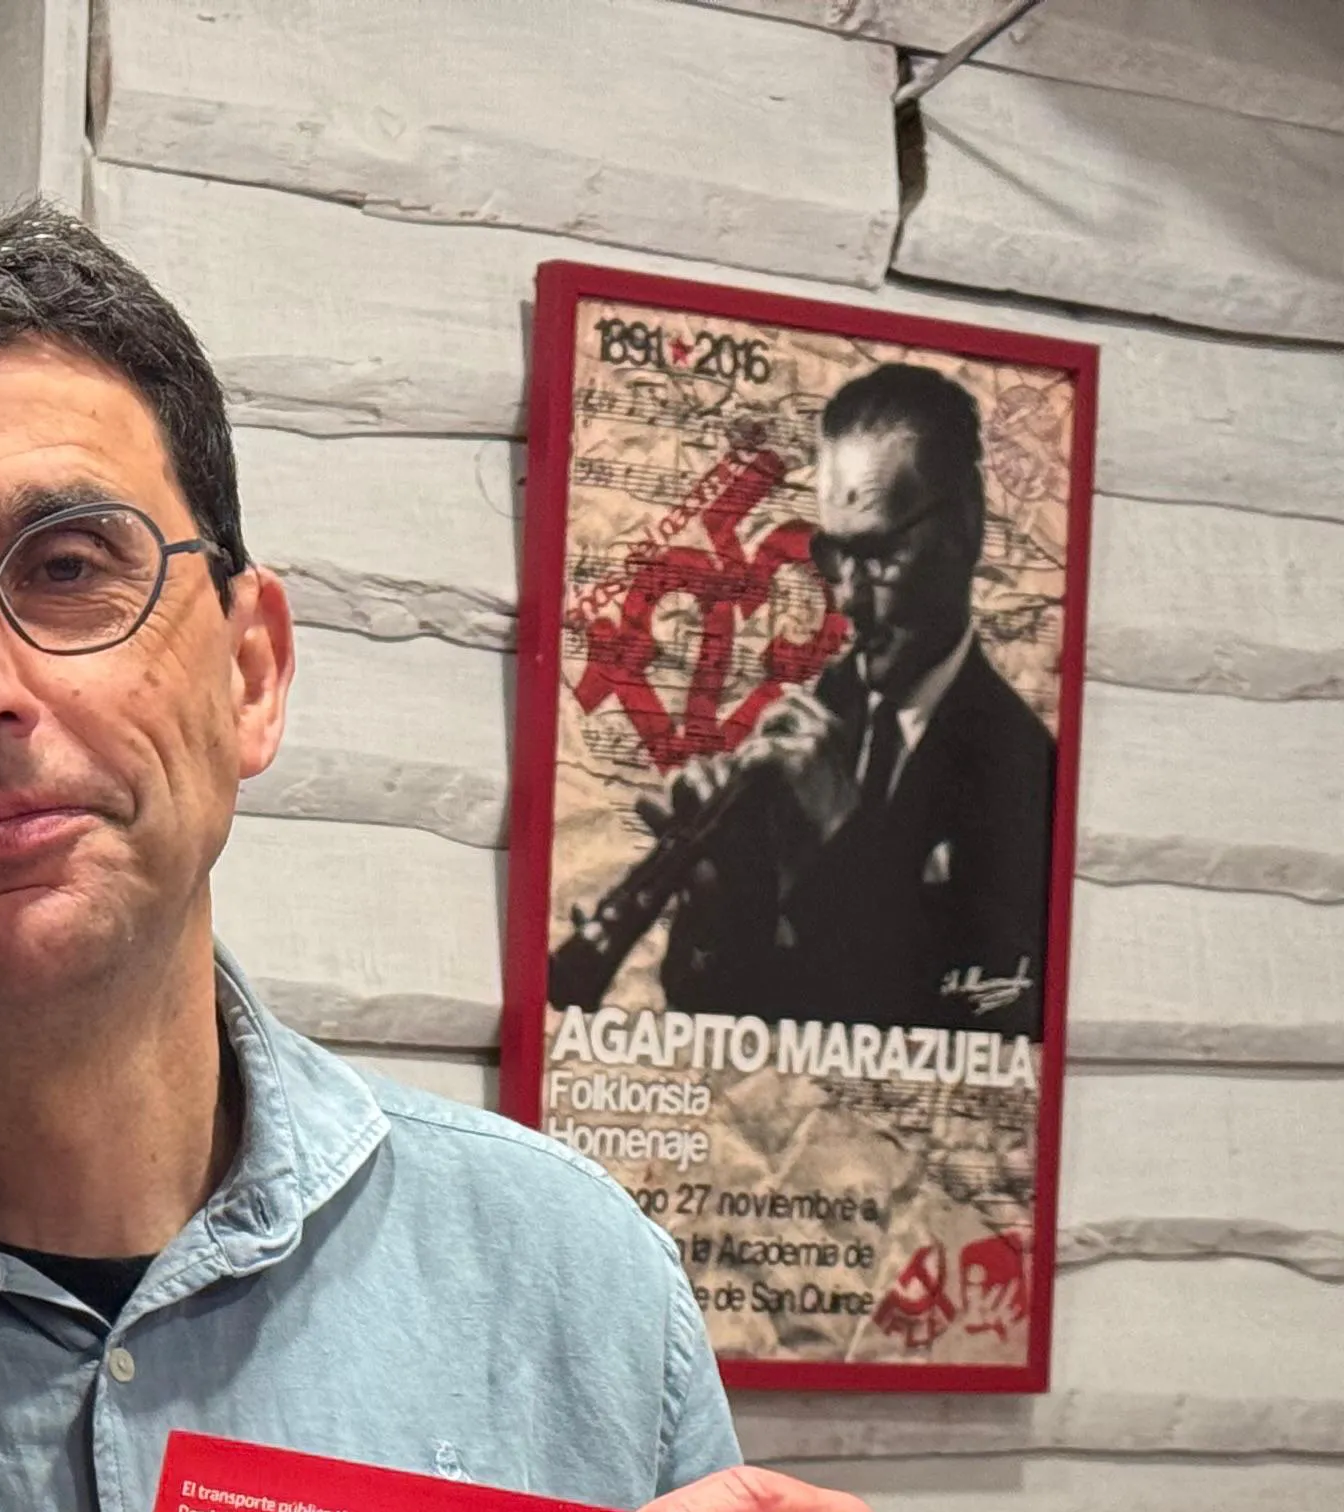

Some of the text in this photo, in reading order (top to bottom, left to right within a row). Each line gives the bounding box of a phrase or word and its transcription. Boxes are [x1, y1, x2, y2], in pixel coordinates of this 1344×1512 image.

[694, 330, 770, 384] 2016
[550, 1005, 1036, 1088] AGAPITO MARAZUELA
[549, 1070, 711, 1115] Folklorista
[548, 1116, 709, 1172] Homenaje
[674, 1182, 712, 1216] 27
[715, 1187, 857, 1221] noviembre
[691, 1233, 711, 1265] la
[716, 1232, 838, 1268] Academia
[843, 1237, 875, 1269] de
[714, 1281, 746, 1312] de
[751, 1281, 797, 1314] San
[800, 1282, 875, 1315] Quirce
